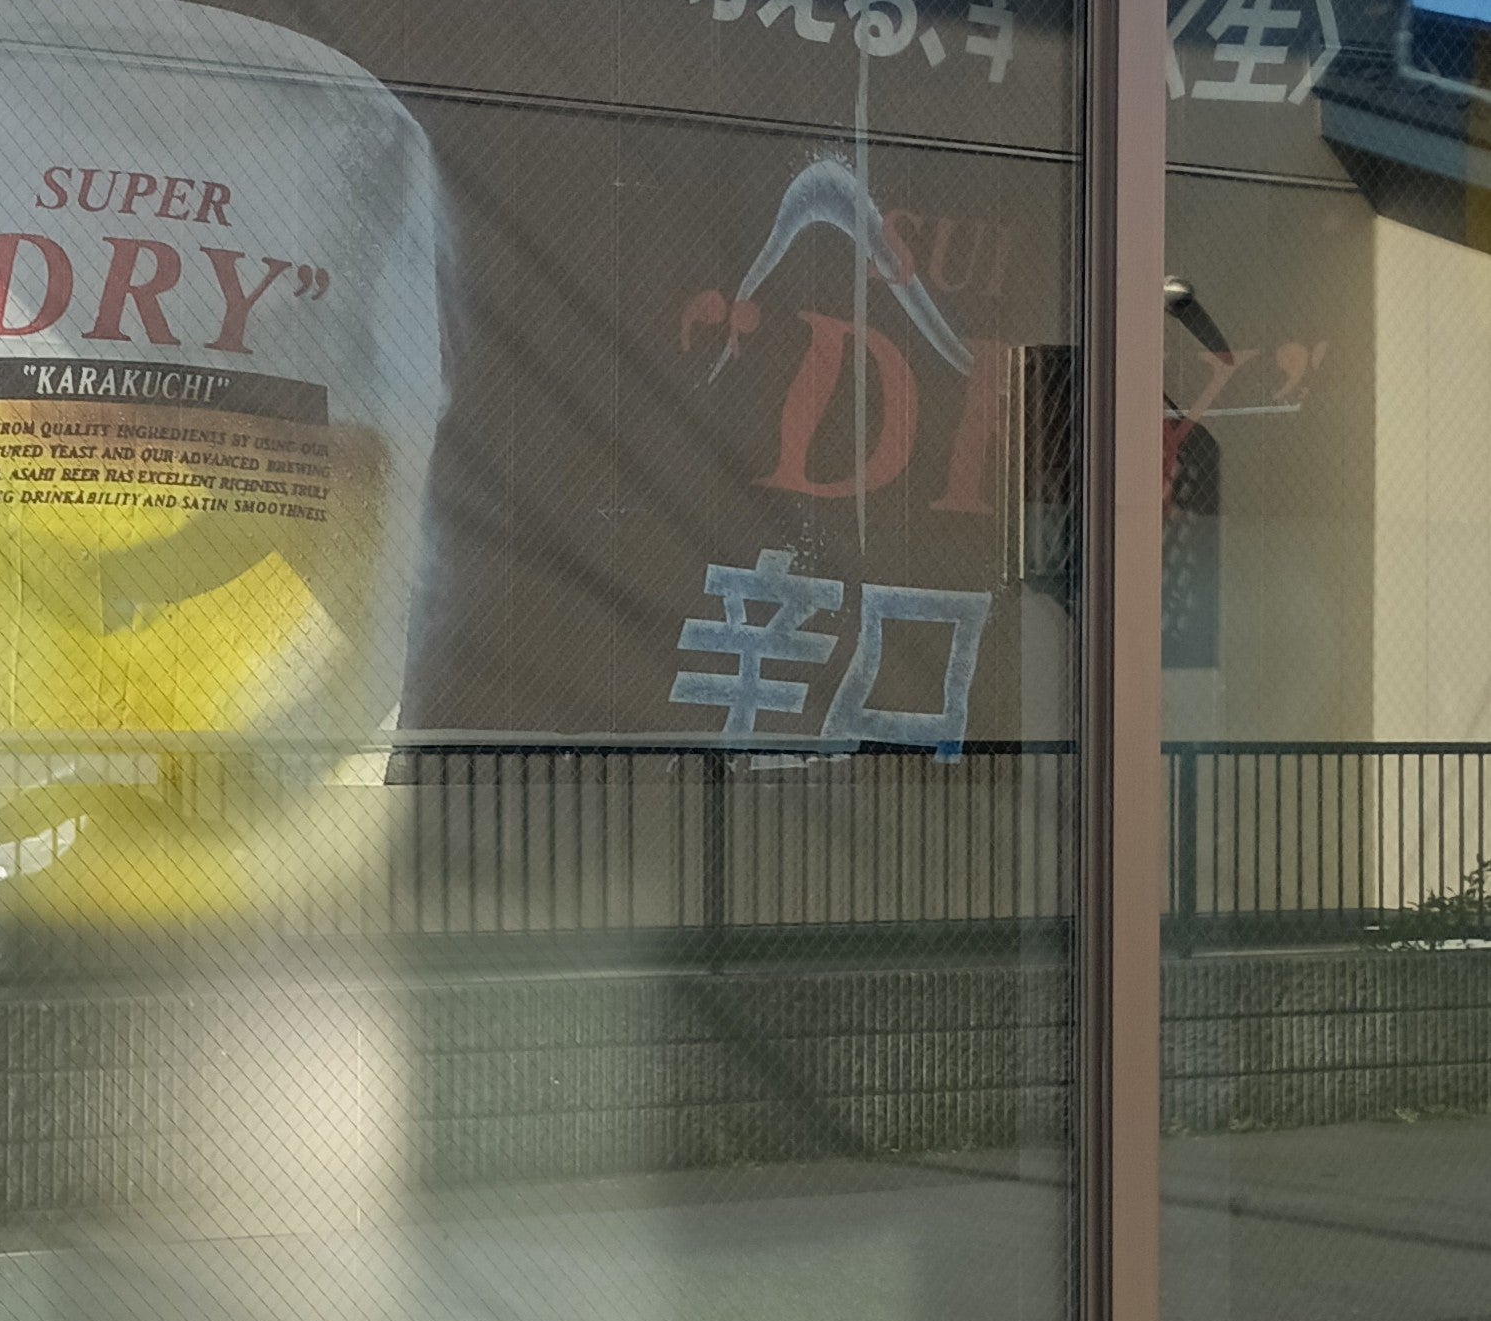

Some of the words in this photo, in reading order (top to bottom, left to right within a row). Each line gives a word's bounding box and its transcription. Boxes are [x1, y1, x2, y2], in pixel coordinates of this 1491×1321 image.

[35, 166, 232, 227] SUPER
[40, 421, 110, 438] QUALITY
[117, 425, 228, 446] INGREDIENTS
[231, 434, 251, 448] BY
[301, 442, 329, 457] OUR
[50, 444, 97, 459] YEAST
[102, 446, 135, 461] AND
[141, 448, 173, 464] OUR
[179, 451, 259, 471] ADVANCED
[10, 466, 56, 482] ASAHI
[62, 468, 101, 482] BEER
[106, 468, 134, 483] HAS
[138, 470, 218, 489] EXCELLENT
[292, 483, 329, 500] TRULY
[21, 490, 141, 506] DRINKABILITY
[143, 493, 177, 508] AND
[183, 495, 228, 511] SATIN
[669, 548, 992, 763] 辛口
